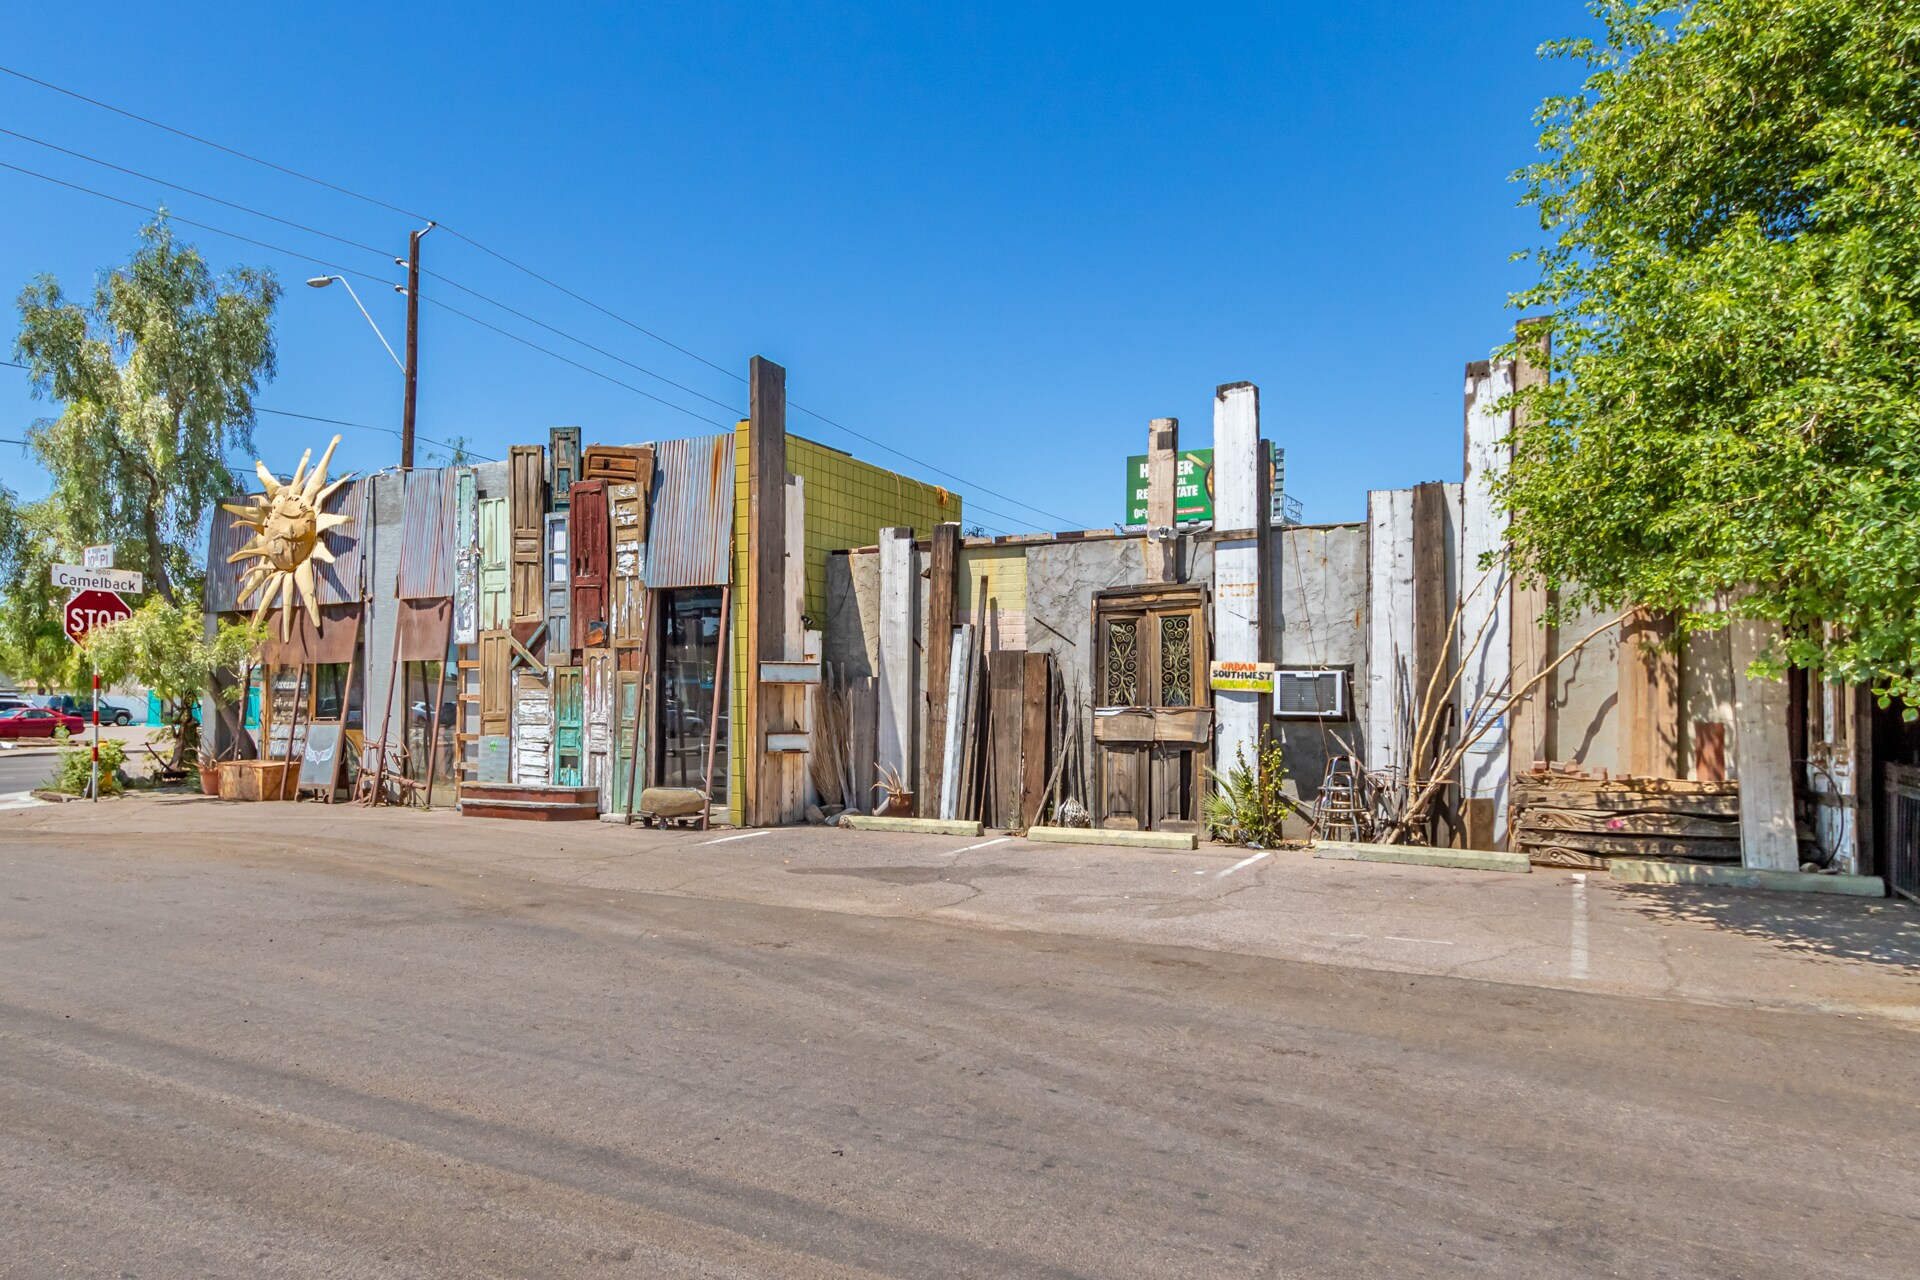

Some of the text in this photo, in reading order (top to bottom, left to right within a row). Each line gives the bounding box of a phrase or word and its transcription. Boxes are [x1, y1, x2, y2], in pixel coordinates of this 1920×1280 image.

[59, 573, 136, 591] Camelback
[1221, 661, 1257, 671] URBAN
[1212, 670, 1273, 681] SOUTHWEST
